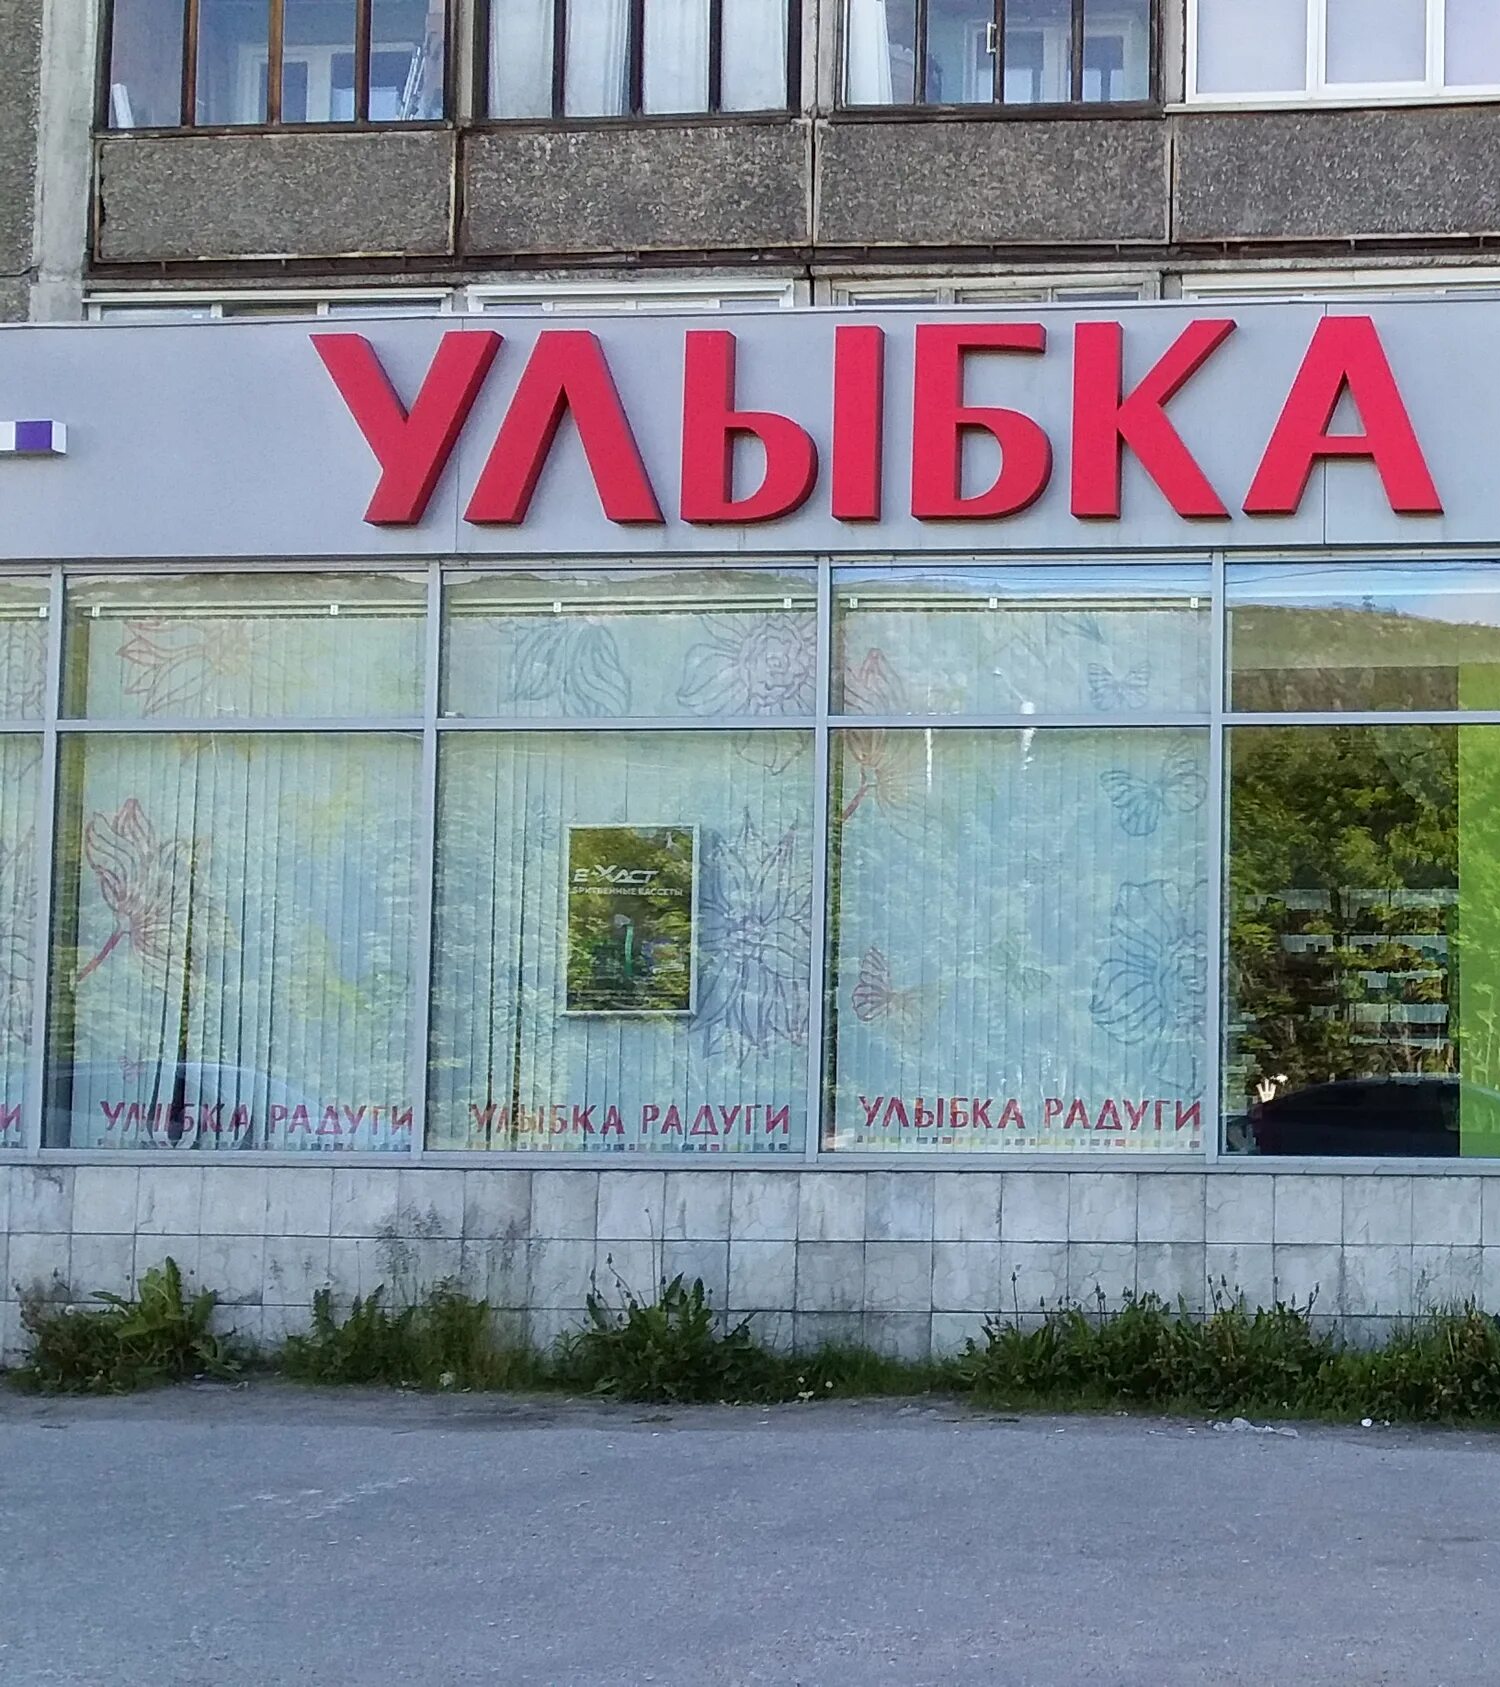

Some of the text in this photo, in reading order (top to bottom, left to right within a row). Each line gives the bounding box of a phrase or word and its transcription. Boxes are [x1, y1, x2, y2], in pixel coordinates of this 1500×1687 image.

[311, 314, 1443, 526] УЛЫБКА
[269, 1103, 413, 1135] РАДУГИ
[469, 1103, 789, 1135] УЛЫБКА РАДУГИ
[858, 1095, 1202, 1131] УЛЫБКА РАДУГИ
